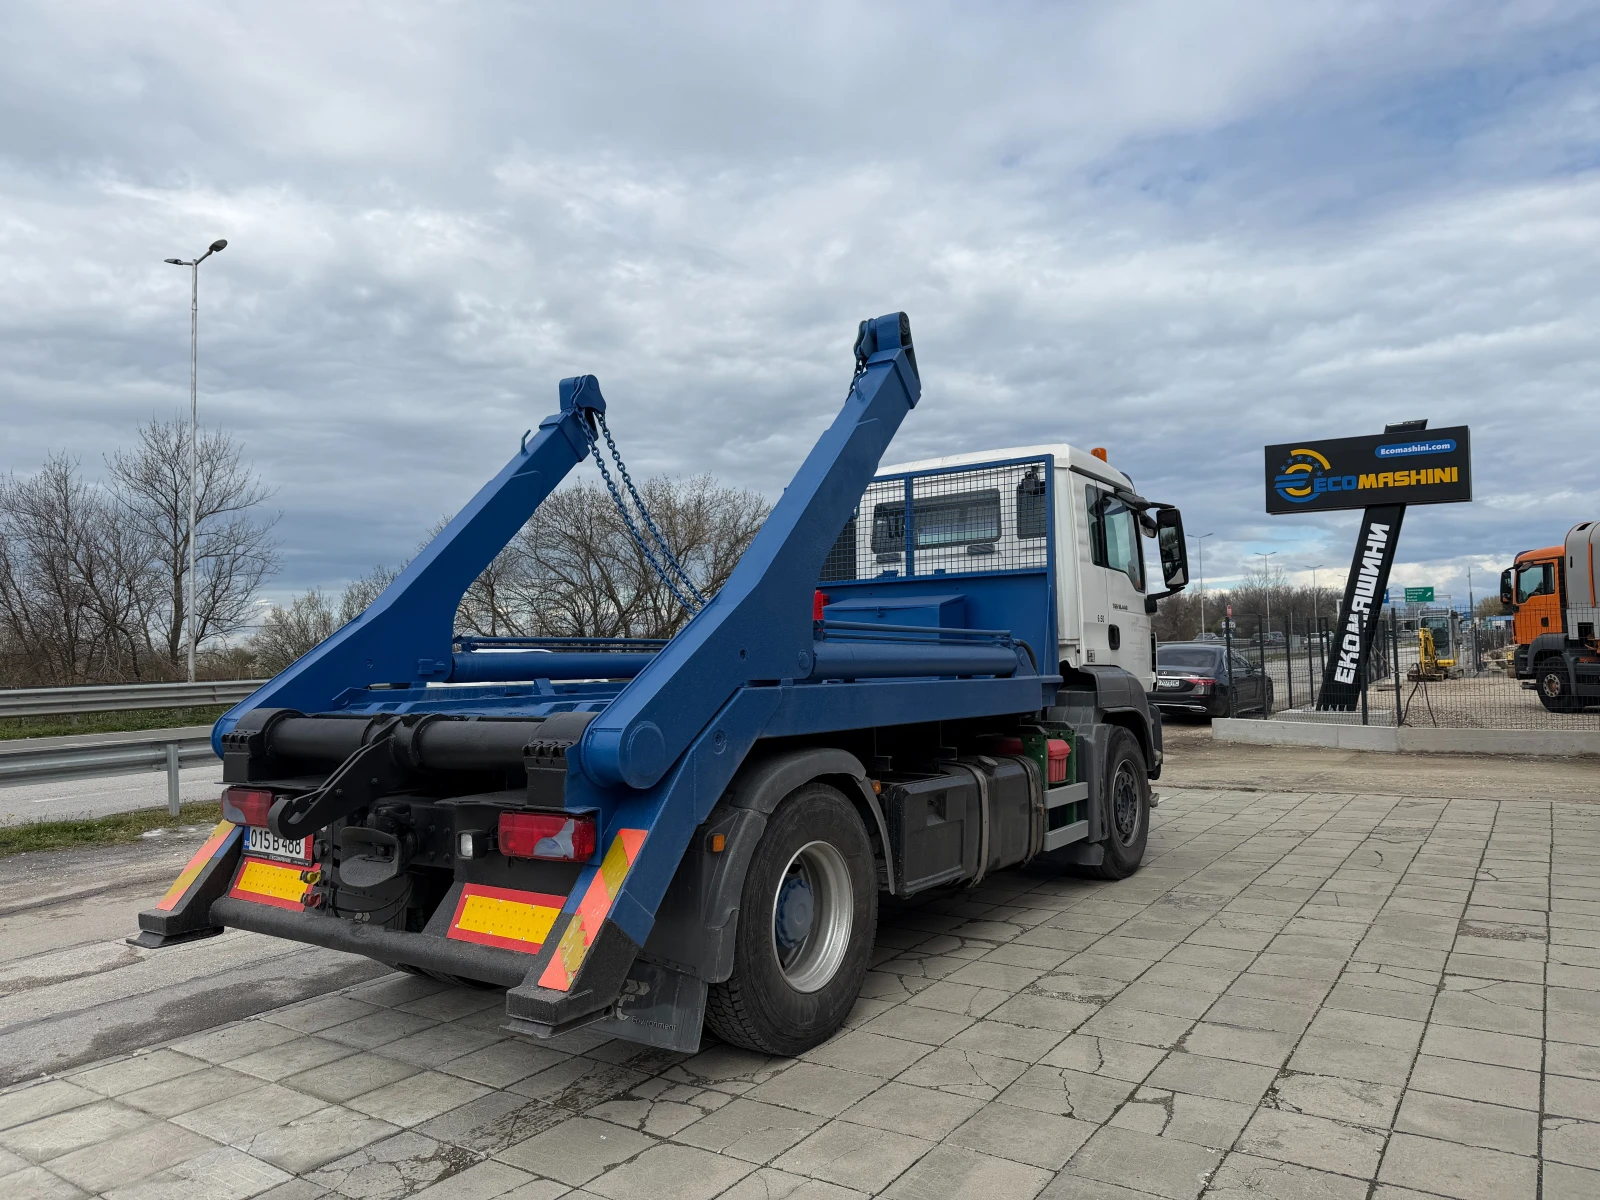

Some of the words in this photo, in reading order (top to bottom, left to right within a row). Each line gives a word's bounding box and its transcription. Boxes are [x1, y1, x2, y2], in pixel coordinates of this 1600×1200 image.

[1380, 442, 1451, 455] Ecomashini.com
[1313, 466, 1458, 493] ECOMASHINI
[631, 1015, 677, 1032] Environment
